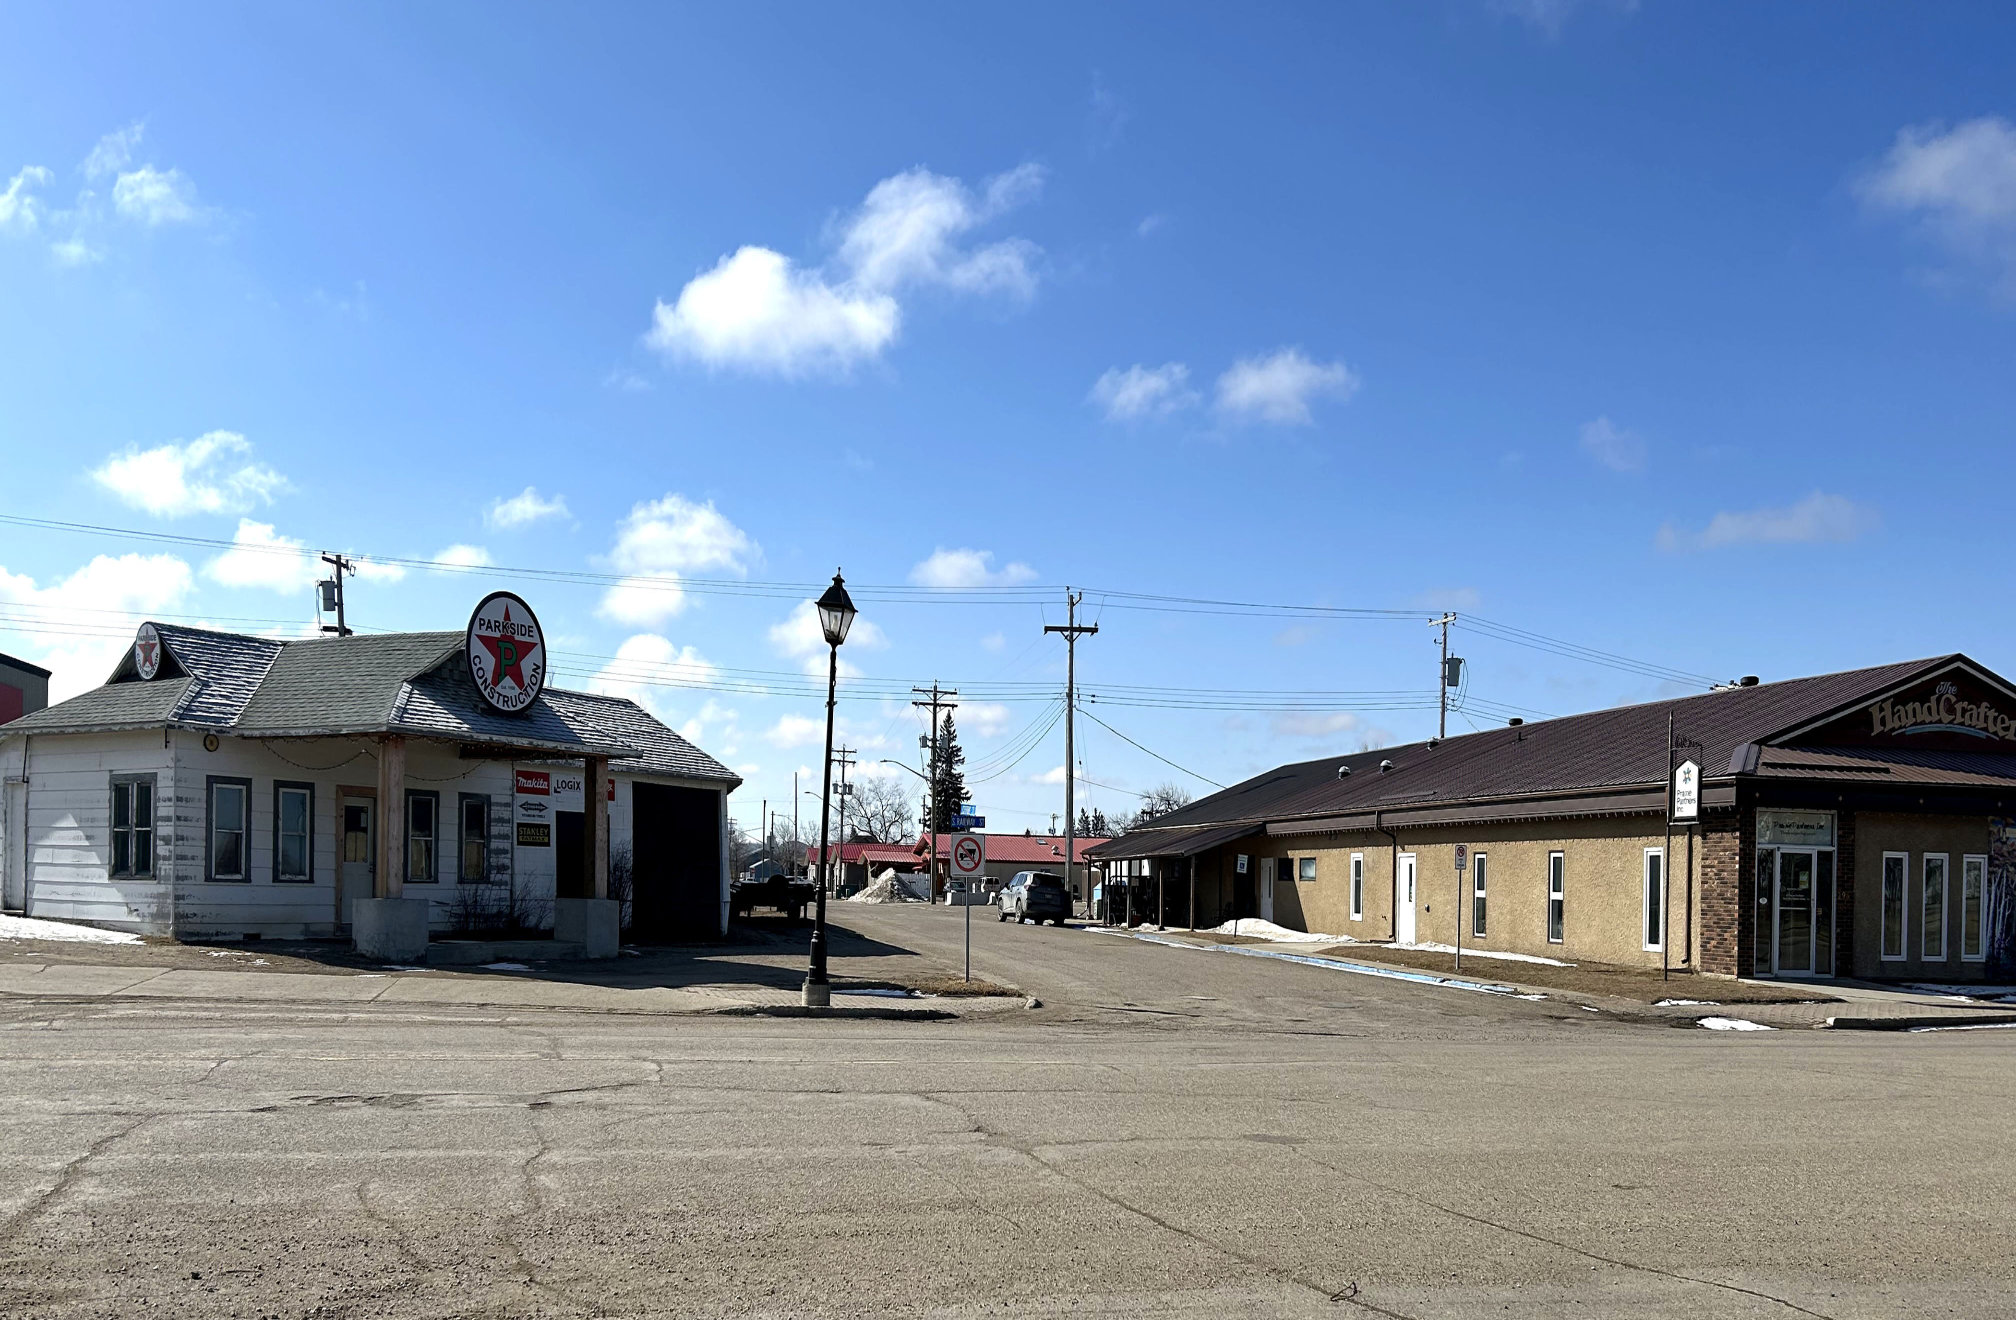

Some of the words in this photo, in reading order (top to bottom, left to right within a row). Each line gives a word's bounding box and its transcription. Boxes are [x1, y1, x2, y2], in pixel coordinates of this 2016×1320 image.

[478, 617, 534, 638] PARKSIDE
[497, 641, 518, 685] P
[472, 655, 542, 709] CONSTRUCTION
[519, 827, 549, 836] STANLEY
